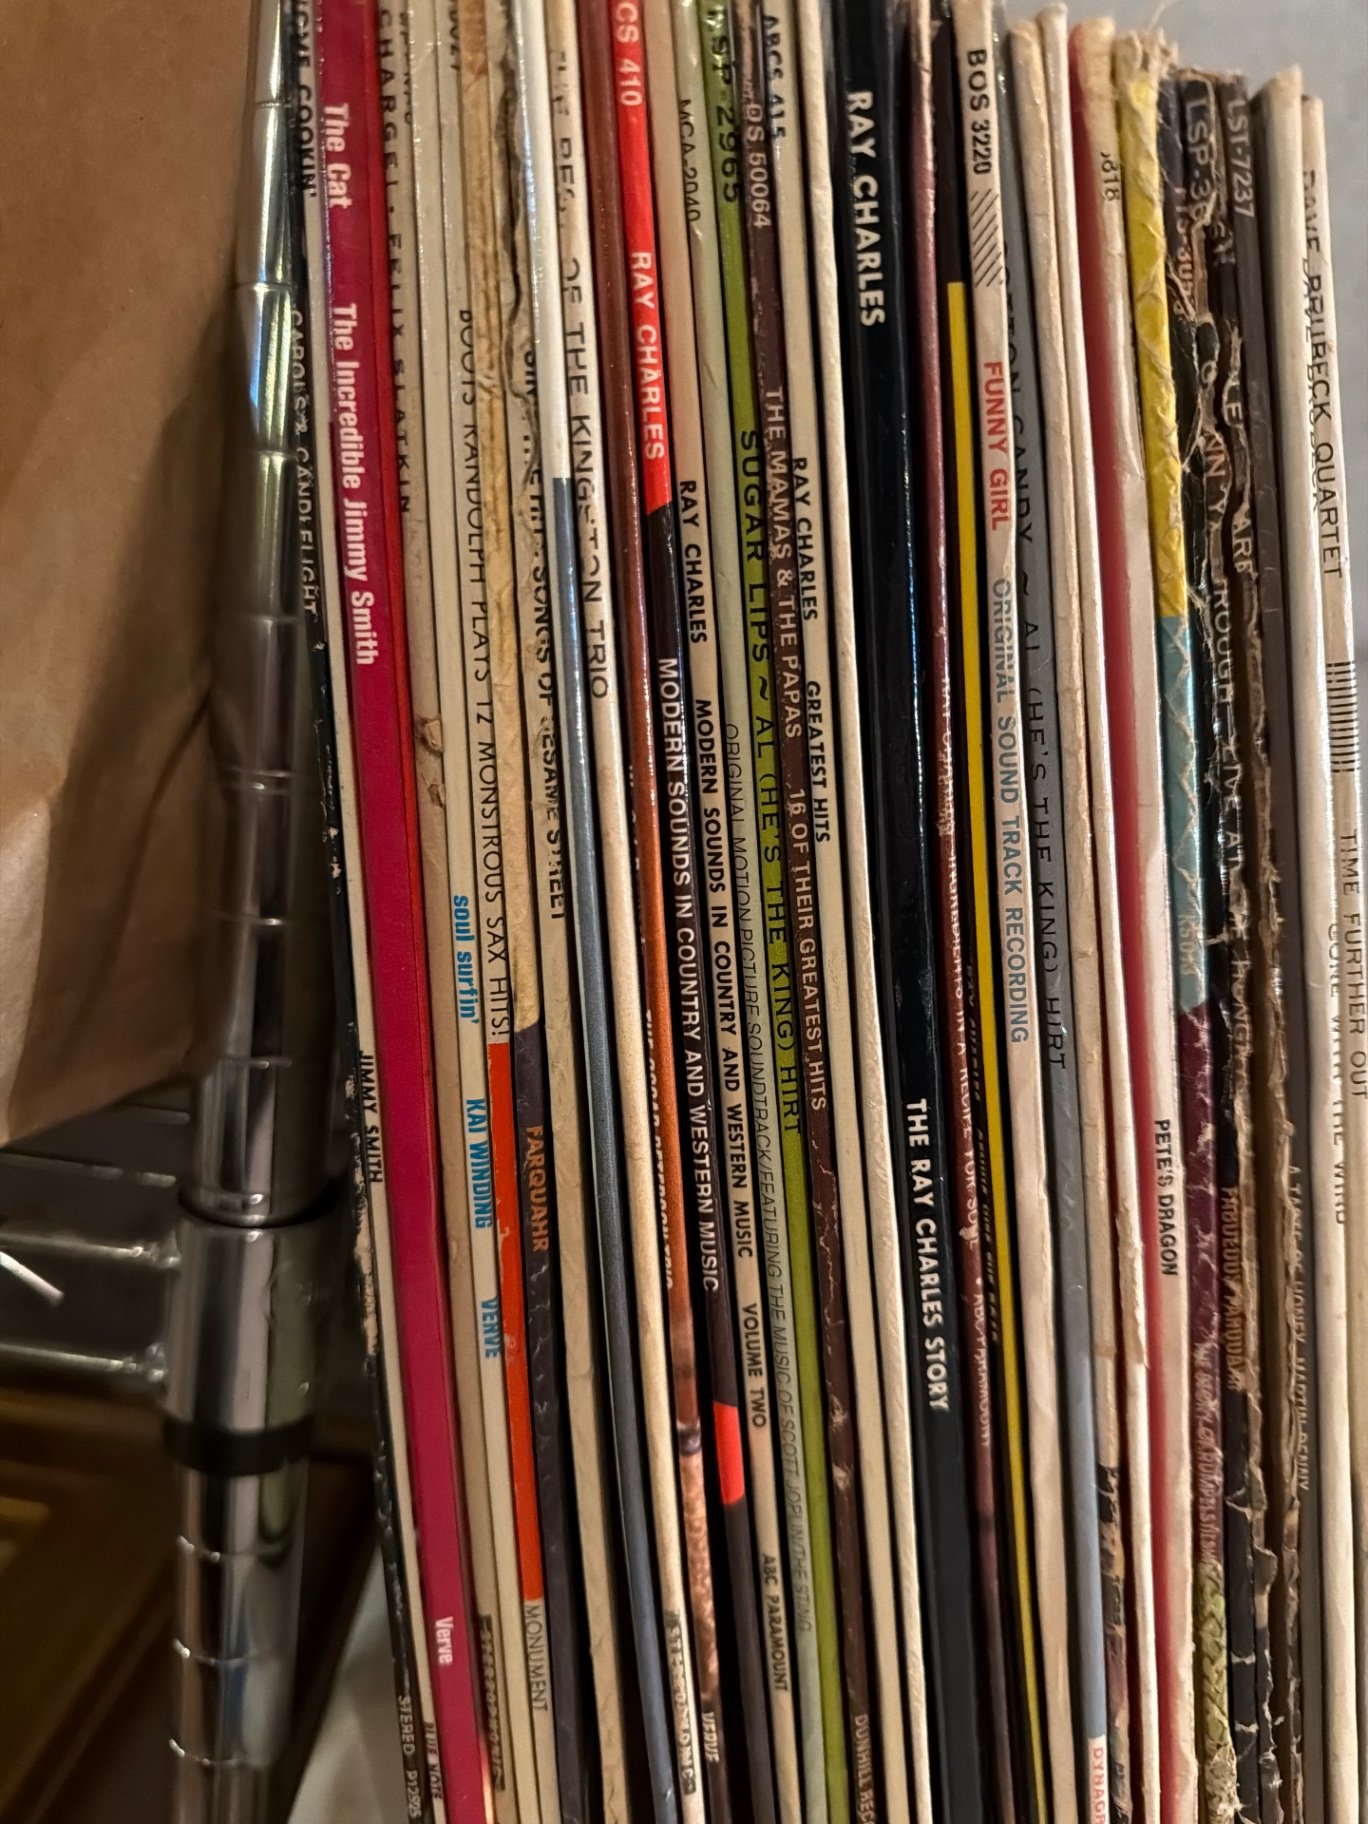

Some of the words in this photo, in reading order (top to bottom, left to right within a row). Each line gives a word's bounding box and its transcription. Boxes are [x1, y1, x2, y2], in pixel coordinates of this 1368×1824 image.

[619, 58, 643, 107] 410
[967, 48, 990, 111] BOS
[324, 103, 350, 151] The
[846, 91, 877, 159] RAY
[971, 119, 994, 175] 3220
[1225, 100, 1255, 217] LST-7237
[326, 163, 354, 209] Cat
[749, 152, 771, 229] 50064
[631, 252, 655, 309] RAY
[852, 175, 886, 327] CHARLES
[333, 304, 359, 350] The
[337, 361, 367, 488] Incredible
[638, 324, 665, 459] CHARLES
[765, 386, 786, 440] THE
[983, 361, 1008, 454] FUNNY
[566, 322, 589, 395] THE
[587, 619, 609, 699] TRIO
[680, 480, 699, 528] RAY
[741, 430, 767, 561] SUGAR
[768, 450, 794, 560] MAMAS
[791, 457, 809, 505] RAY
[989, 468, 1009, 531] GIRL
[1313, 442, 1342, 579] QUARTET
[341, 498, 370, 581] Jimmy
[795, 518, 818, 620] CHARLES
[685, 543, 707, 644] CHARLES
[776, 568, 795, 589] &
[350, 591, 378, 665] Smith
[471, 601, 492, 681] PLAYS
[749, 583, 769, 663] LIPS
[777, 599, 798, 647] THE
[992, 578, 1015, 703] ORIGINAL
[476, 700, 494, 725] 12
[657, 658, 686, 772] MODERN
[780, 655, 803, 739] PAPAS
[695, 699, 718, 794] MODERN
[755, 716, 776, 759] AL
[805, 681, 827, 788] GREATEST
[997, 715, 1019, 804] SOUND
[477, 741, 503, 902] MONSTROUS
[667, 781, 690, 886] SOUNDS
[788, 789, 807, 816] 16
[791, 823, 810, 854] OF
[813, 799, 830, 843] HITS
[703, 807, 726, 893] SOUNDS
[731, 836, 753, 922] MOTION
[1002, 815, 1023, 896] TRACK
[1340, 828, 1361, 895] TIME
[453, 895, 475, 941] soul
[674, 895, 693, 919] IN
[710, 905, 728, 928] IN
[767, 881, 787, 946] THE
[793, 863, 815, 929] THEIR
[1038, 882, 1060, 974] KING)
[488, 916, 506, 964] SAX
[741, 928, 760, 1017] PICTURE
[1005, 906, 1030, 1044] RECORDING
[1342, 913, 1366, 1035] FURTHER
[457, 951, 480, 1025] surfin'
[489, 978, 510, 1036] HITS!
[677, 927, 701, 1041] COUNTRY
[714, 940, 736, 1036] COUNTRY
[771, 963, 795, 1051] KING)
[799, 938, 823, 1054] GREATEST
[1046, 997, 1066, 1070] HIRT
[359, 1052, 377, 1112] JIMMY
[685, 1049, 707, 1097] AND
[722, 1048, 740, 1092] AND
[780, 1066, 802, 1135] HIRT
[808, 1061, 827, 1112] HITS
[1350, 1050, 1368, 1099] OUT
[466, 1098, 488, 1132] KAI
[726, 1103, 747, 1190] WESTERN
[906, 1098, 928, 1147] THE
[364, 1124, 383, 1184] SMITH
[470, 1140, 493, 1229] WINDING
[526, 1124, 549, 1251] FARQUAHR
[689, 1104, 714, 1213] WESTERN
[910, 1159, 935, 1207] RAY
[1155, 1119, 1175, 1187] PETE'S
[697, 1220, 719, 1292] MUSIC
[733, 1200, 753, 1259] MUSIC
[1157, 1194, 1178, 1276] DRAGON
[768, 1284, 786, 1320] THE
[915, 1218, 945, 1328] CHARLES
[480, 1297, 502, 1359] VERVE
[742, 1303, 762, 1378] VOLUME
[772, 1325, 791, 1384] MUSIC
[750, 1387, 767, 1429] TWO
[777, 1389, 795, 1415] OF
[924, 1336, 949, 1411] STORY
[780, 1420, 799, 1477] SCOTT
[761, 1553, 778, 1585] ABC
[435, 1616, 454, 1666] Verve
[524, 1604, 548, 1712] MONUMENT
[767, 1594, 788, 1692] PARAMOUNT
[854, 1714, 873, 1788] DUNHILL
